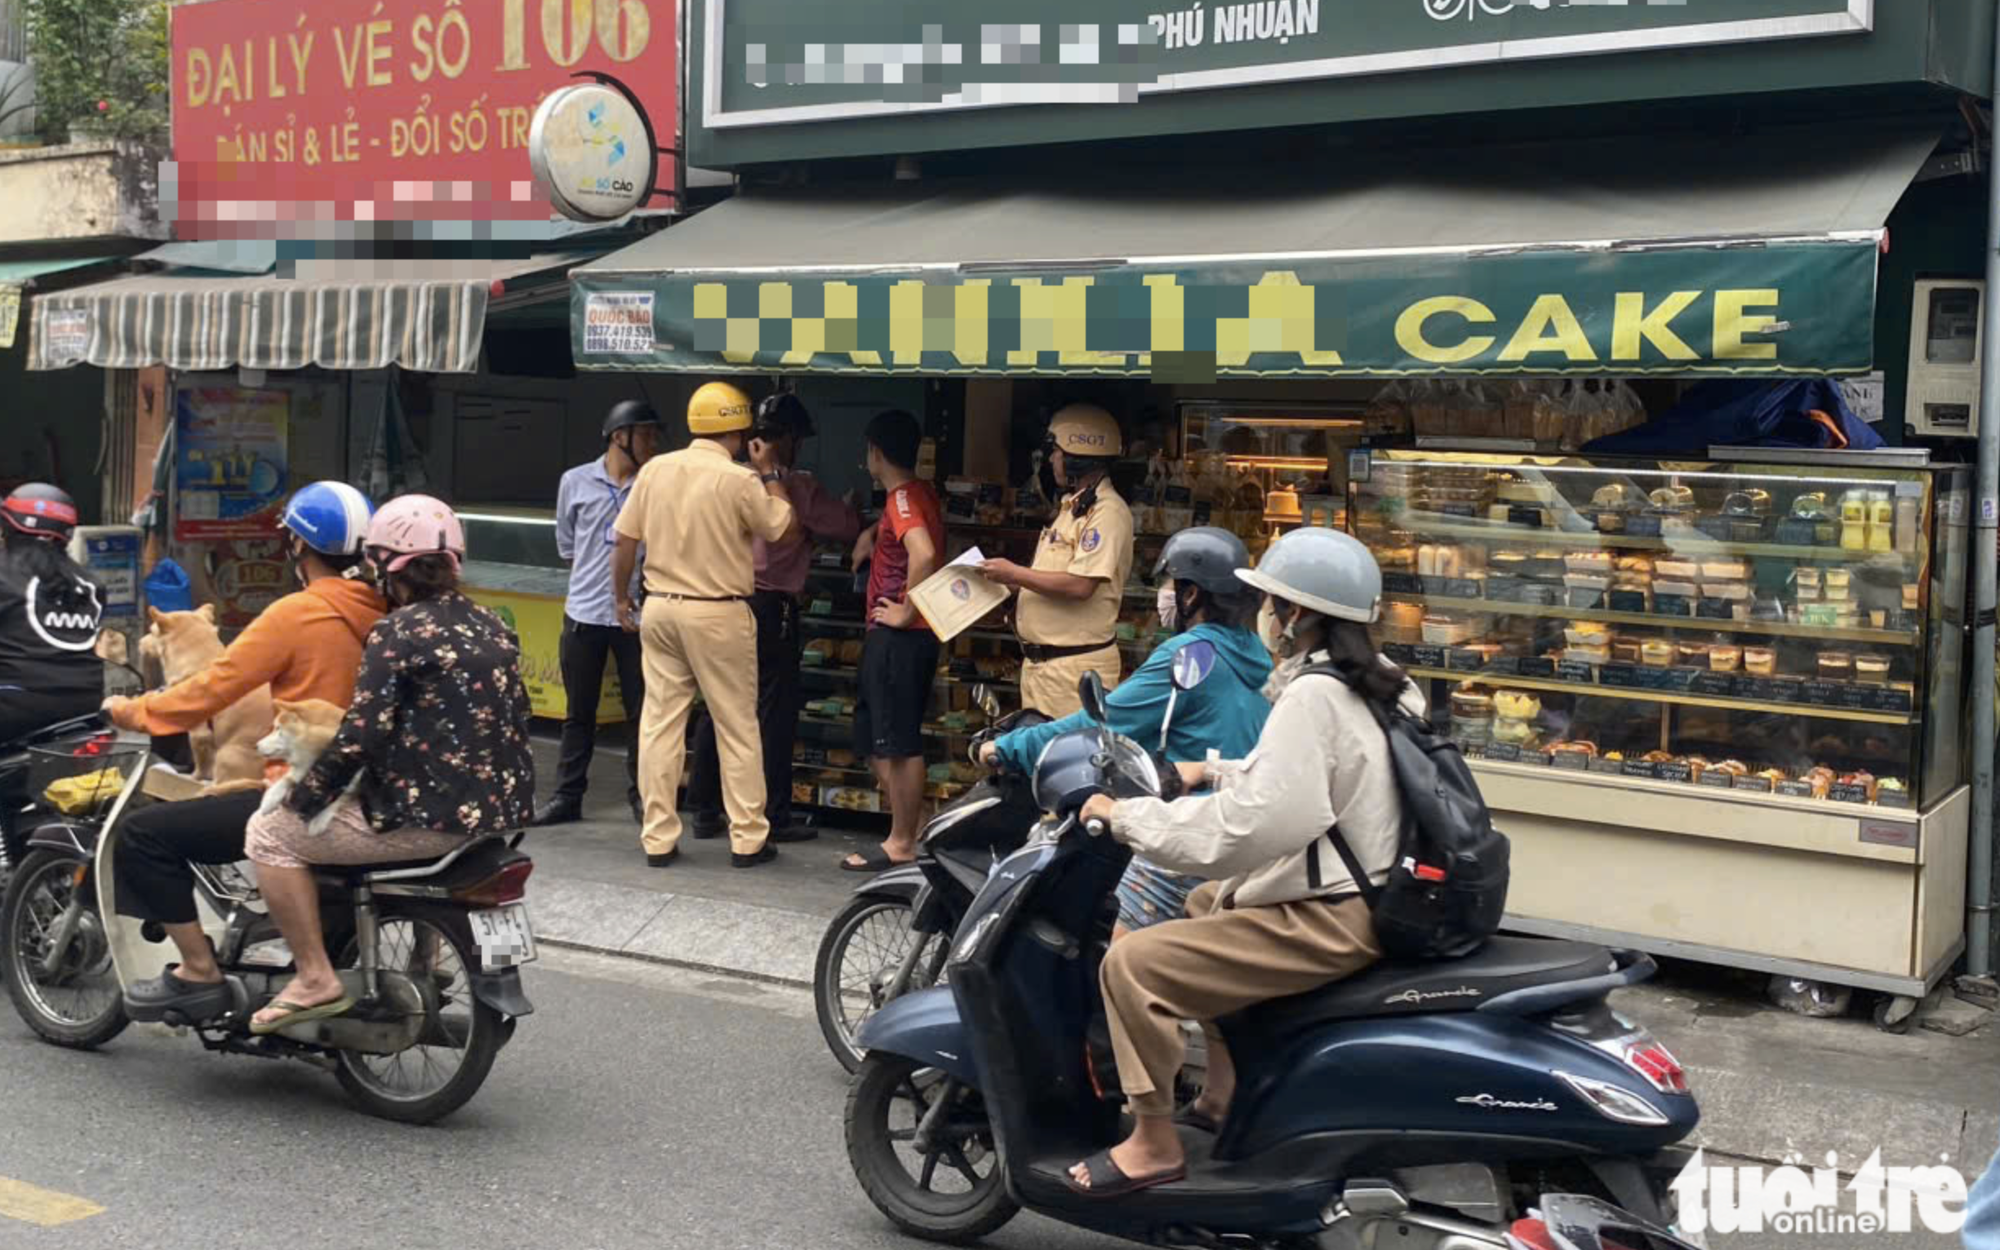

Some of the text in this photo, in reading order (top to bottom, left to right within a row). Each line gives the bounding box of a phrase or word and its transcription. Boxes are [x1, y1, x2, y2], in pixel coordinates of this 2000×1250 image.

[187, 40, 253, 117] ĐẠI
[269, 13, 315, 98] LÝ
[334, 0, 393, 89] VÉ
[495, 0, 651, 71] 106
[216, 122, 267, 162] ÁN
[302, 126, 322, 166] &
[330, 105, 360, 162] LẺ
[390, 93, 441, 158] ĐỔI
[450, 92, 488, 153] SỐ
[1393, 288, 1779, 363] CAKE
